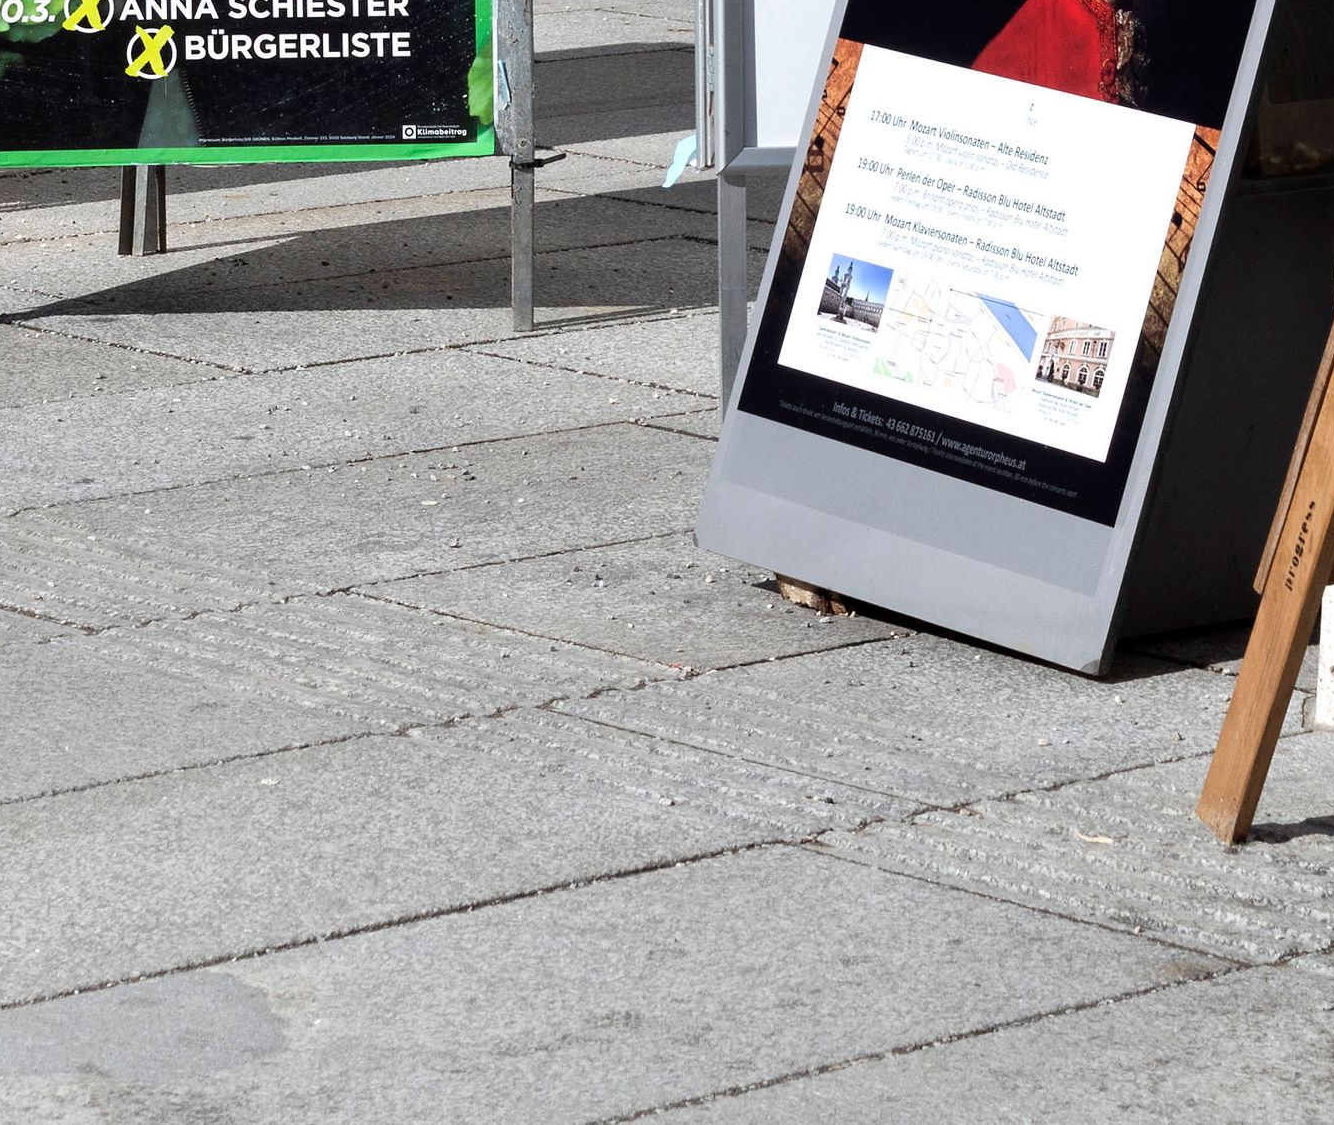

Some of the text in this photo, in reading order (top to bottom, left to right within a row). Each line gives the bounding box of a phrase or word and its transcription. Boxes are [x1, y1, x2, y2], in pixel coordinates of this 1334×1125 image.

[184, 29, 411, 61] BÜRGERLISTE
[870, 109, 892, 125] 17:00
[892, 117, 907, 129] Uhr
[909, 119, 937, 138] Mozart
[938, 125, 990, 150] Violinsonaten
[997, 142, 1014, 157] Alte
[1014, 146, 1049, 165] Residenz
[857, 157, 880, 173] 19:00
[879, 164, 894, 177] Uhr
[896, 167, 921, 184] Perlen
[921, 174, 936, 188] der
[936, 178, 956, 195] Oper
[962, 184, 997, 205] Radisson
[998, 194, 1012, 208] Blu
[1012, 197, 1034, 214] Hotel
[1034, 204, 1066, 223] Altstadt
[844, 203, 867, 219] 19:00
[866, 209, 882, 223] Uhr
[884, 213, 912, 232] Mozart
[912, 220, 968, 246] Klaviersonaten
[975, 237, 1010, 258] Radisson
[1010, 247, 1024, 262] Blu
[1024, 250, 1047, 267] Hotel
[1047, 257, 1079, 277] Altstadt
[832, 401, 850, 416] Infos
[850, 406, 859, 419] &
[858, 408, 885, 426] Tickets:
[886, 418, 896, 430] 43
[895, 421, 910, 435] 662
[909, 424, 936, 443] 875161
[941, 436, 1028, 471] www.agenturorpheus.at
[1284, 500, 1317, 592] progress
